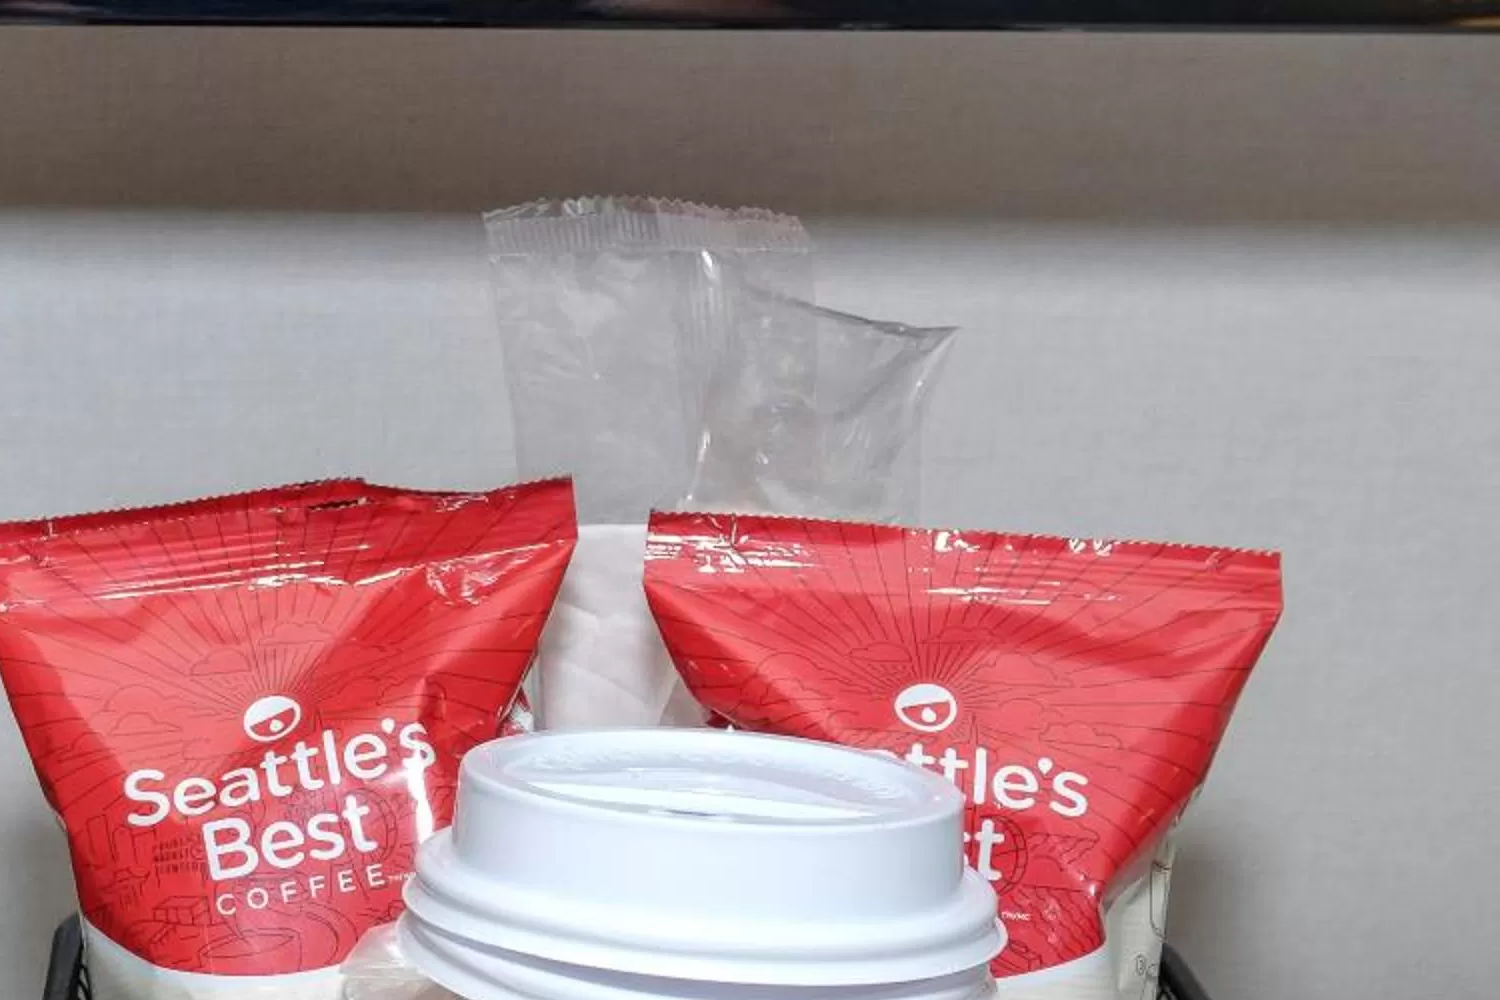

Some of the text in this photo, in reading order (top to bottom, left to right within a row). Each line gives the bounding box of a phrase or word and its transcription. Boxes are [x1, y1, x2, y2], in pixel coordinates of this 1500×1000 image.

[123, 718, 437, 827] Seattle's
[202, 795, 379, 882] Best
[216, 863, 386, 916] COFFEE
